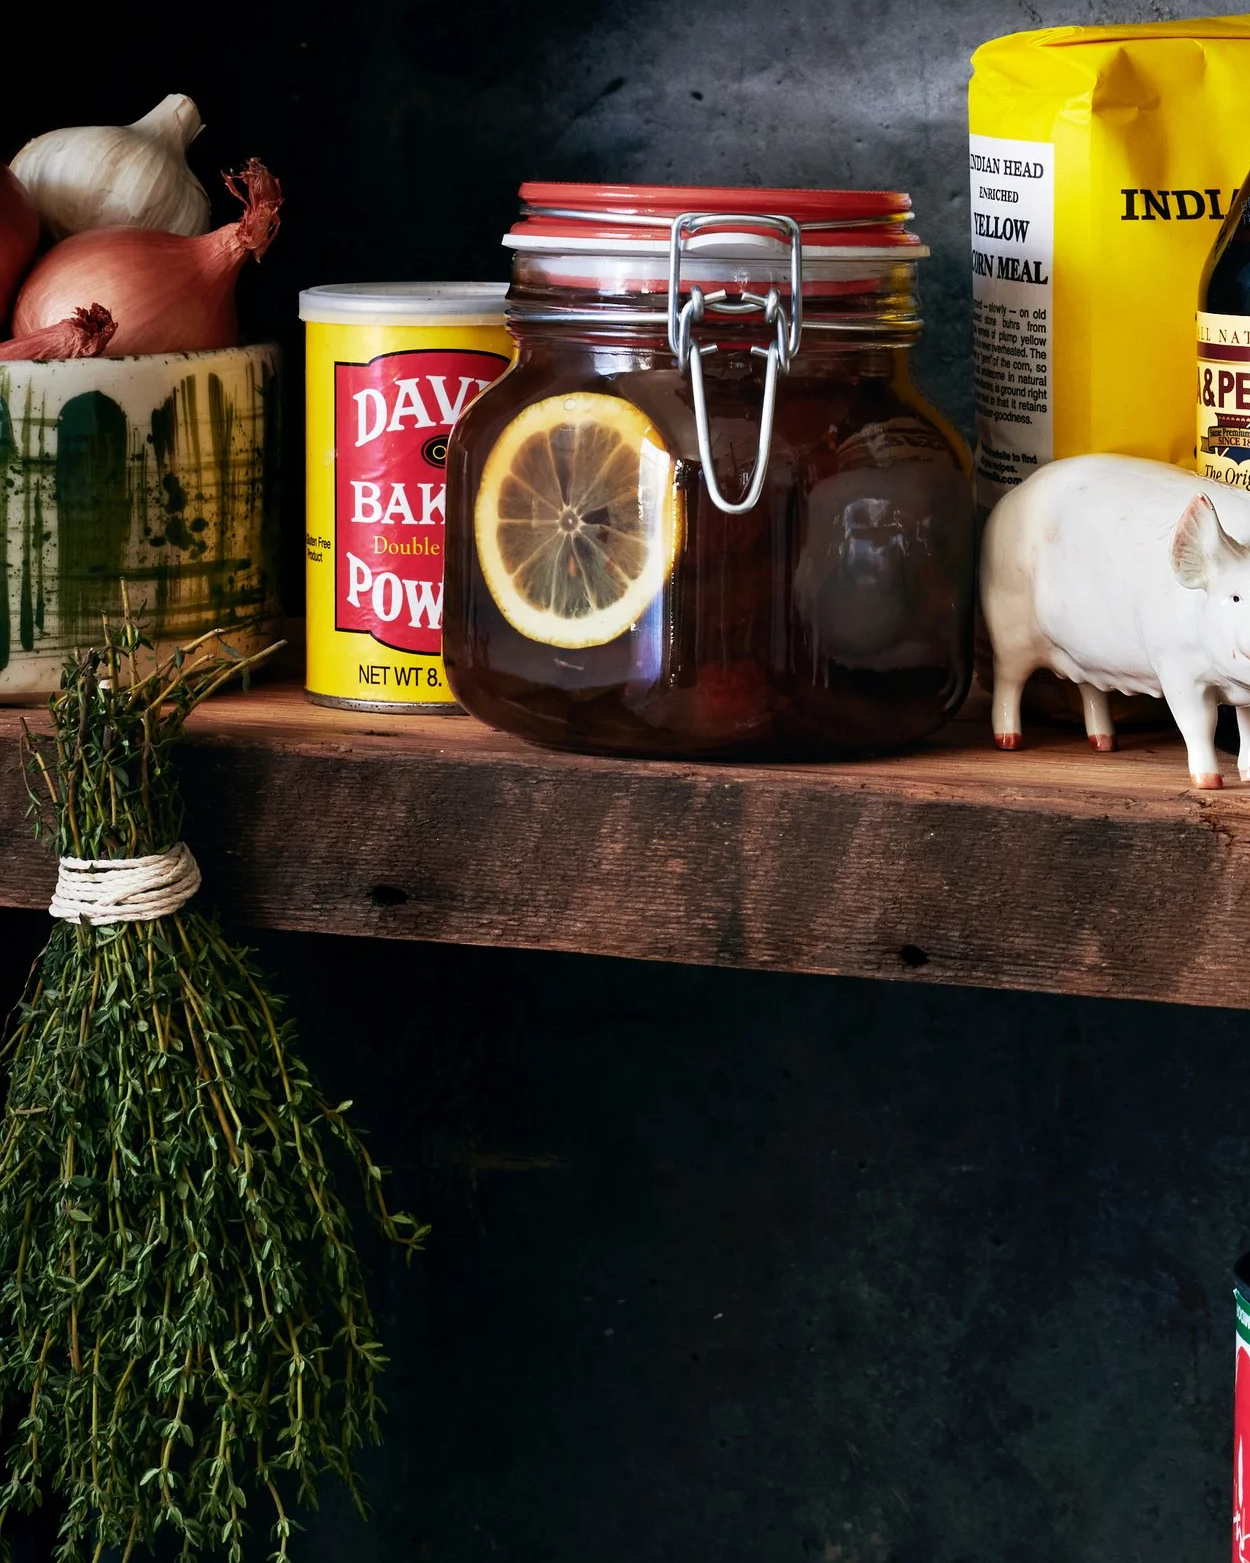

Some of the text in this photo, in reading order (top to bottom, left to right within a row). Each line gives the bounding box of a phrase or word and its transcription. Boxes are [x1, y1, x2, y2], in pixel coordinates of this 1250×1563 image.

[1003, 159, 1044, 179] HEAD
[979, 186, 1019, 203] ENRICHED
[1120, 188, 1240, 221] INDI
[974, 212, 1030, 243] YELLOW
[997, 255, 1049, 285] MEAL
[1019, 309, 1029, 318] on
[1033, 308, 1046, 320] old
[1002, 318, 1020, 330] buhrs
[1027, 321, 1047, 333] from
[999, 331, 1018, 345] plump
[1020, 335, 1047, 347] yellow
[1030, 347, 1047, 360] The
[1001, 357, 1011, 368] the
[1036, 363, 1047, 374] so
[1008, 371, 1015, 383] in
[1018, 374, 1047, 387] natural
[1001, 384, 1027, 398] ground
[1027, 387, 1047, 401] right
[996, 397, 1010, 408] that
[1011, 398, 1017, 409] it
[1019, 401, 1048, 414] retains
[1219, 436, 1241, 446] SINCE
[1012, 452, 1021, 462] to
[1021, 453, 1038, 465] find
[1205, 464, 1223, 480] The
[318, 536, 331, 549] Free
[374, 535, 441, 556] Double
[308, 548, 323, 563] Product
[359, 664, 391, 685] NET
[394, 666, 423, 687] WT
